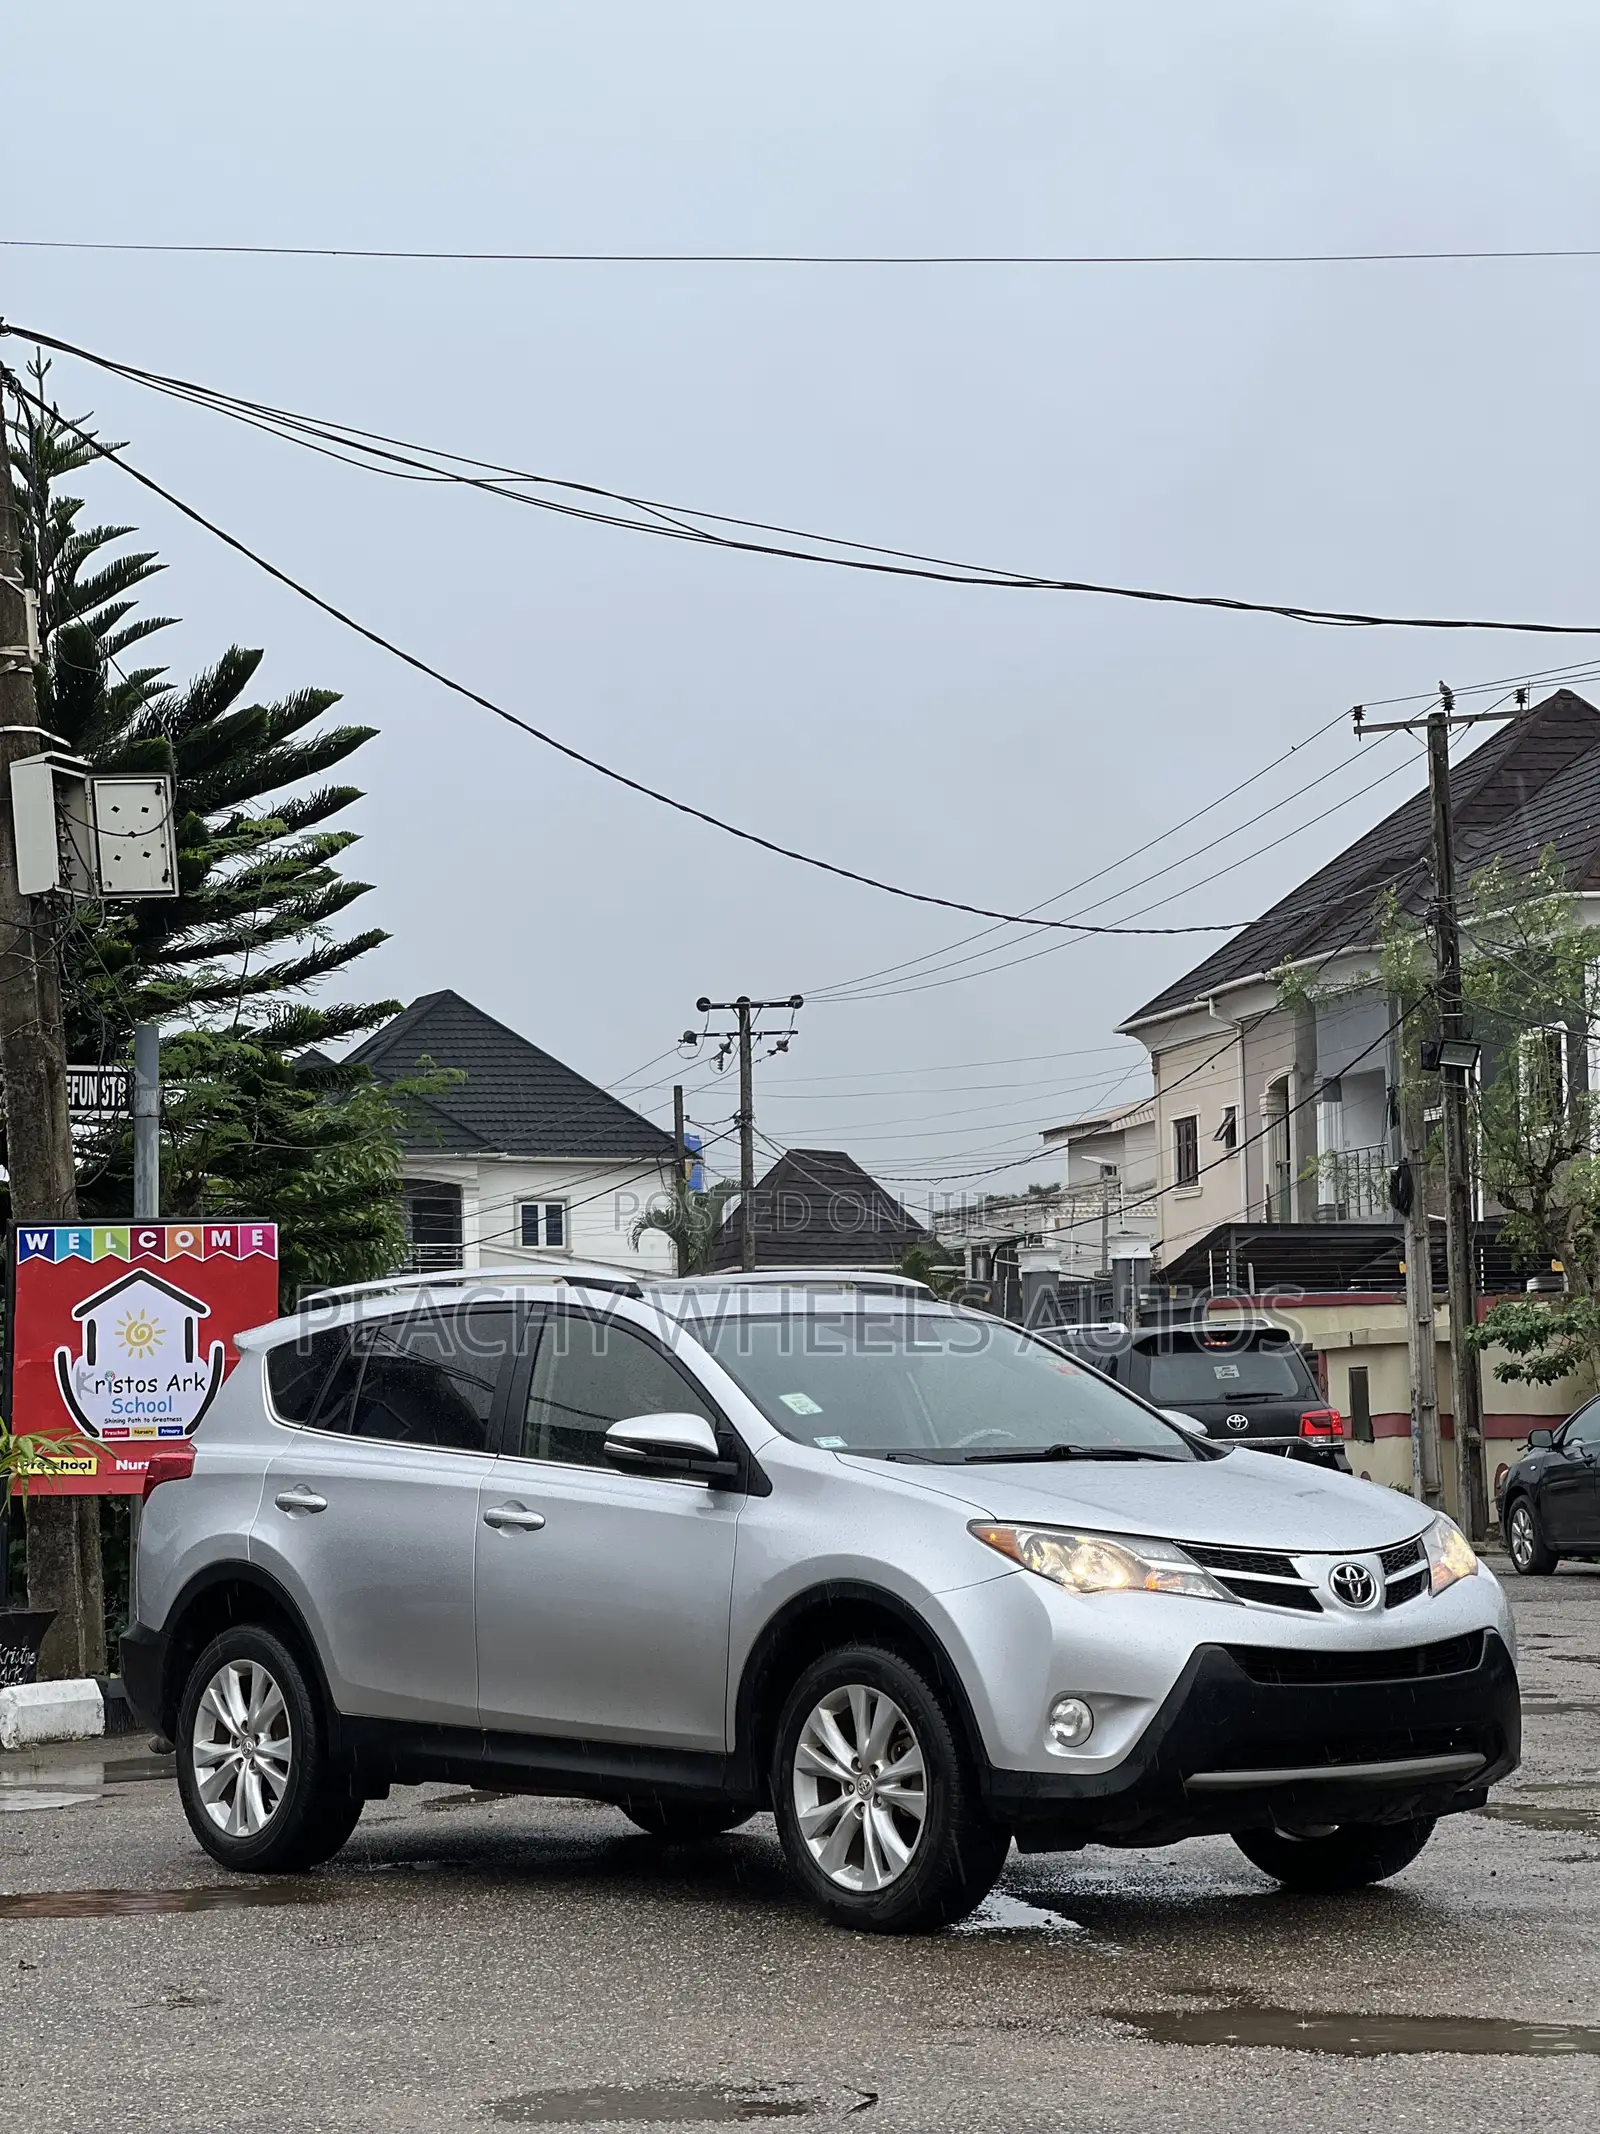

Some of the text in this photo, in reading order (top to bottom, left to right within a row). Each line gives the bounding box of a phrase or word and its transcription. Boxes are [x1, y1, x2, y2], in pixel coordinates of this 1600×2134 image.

[101, 1076, 127, 1106] STR
[25, 1229, 263, 1251] WELCOME
[76, 1366, 206, 1400] Kristos Ark
[111, 1395, 172, 1414] School
[104, 1417, 126, 1425] Shining
